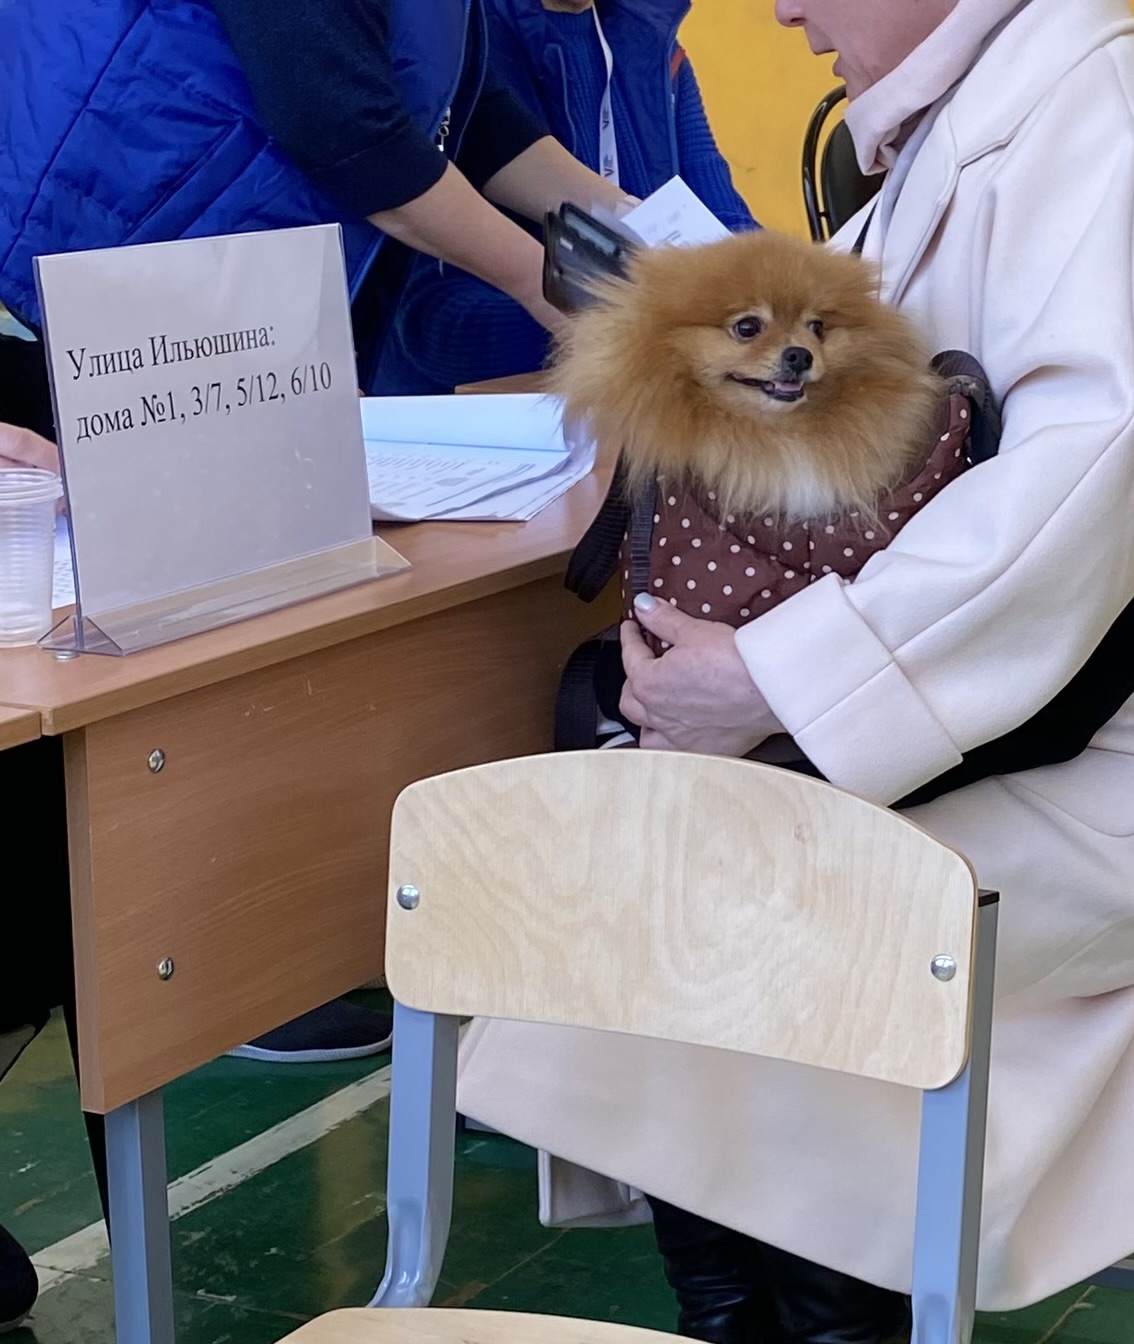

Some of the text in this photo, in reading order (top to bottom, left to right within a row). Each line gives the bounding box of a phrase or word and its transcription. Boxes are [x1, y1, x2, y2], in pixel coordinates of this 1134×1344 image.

[66, 325, 276, 380] Улица Ильюшина:
[76, 361, 332, 444] дома №1, 3/7, 5/12, 6/10
